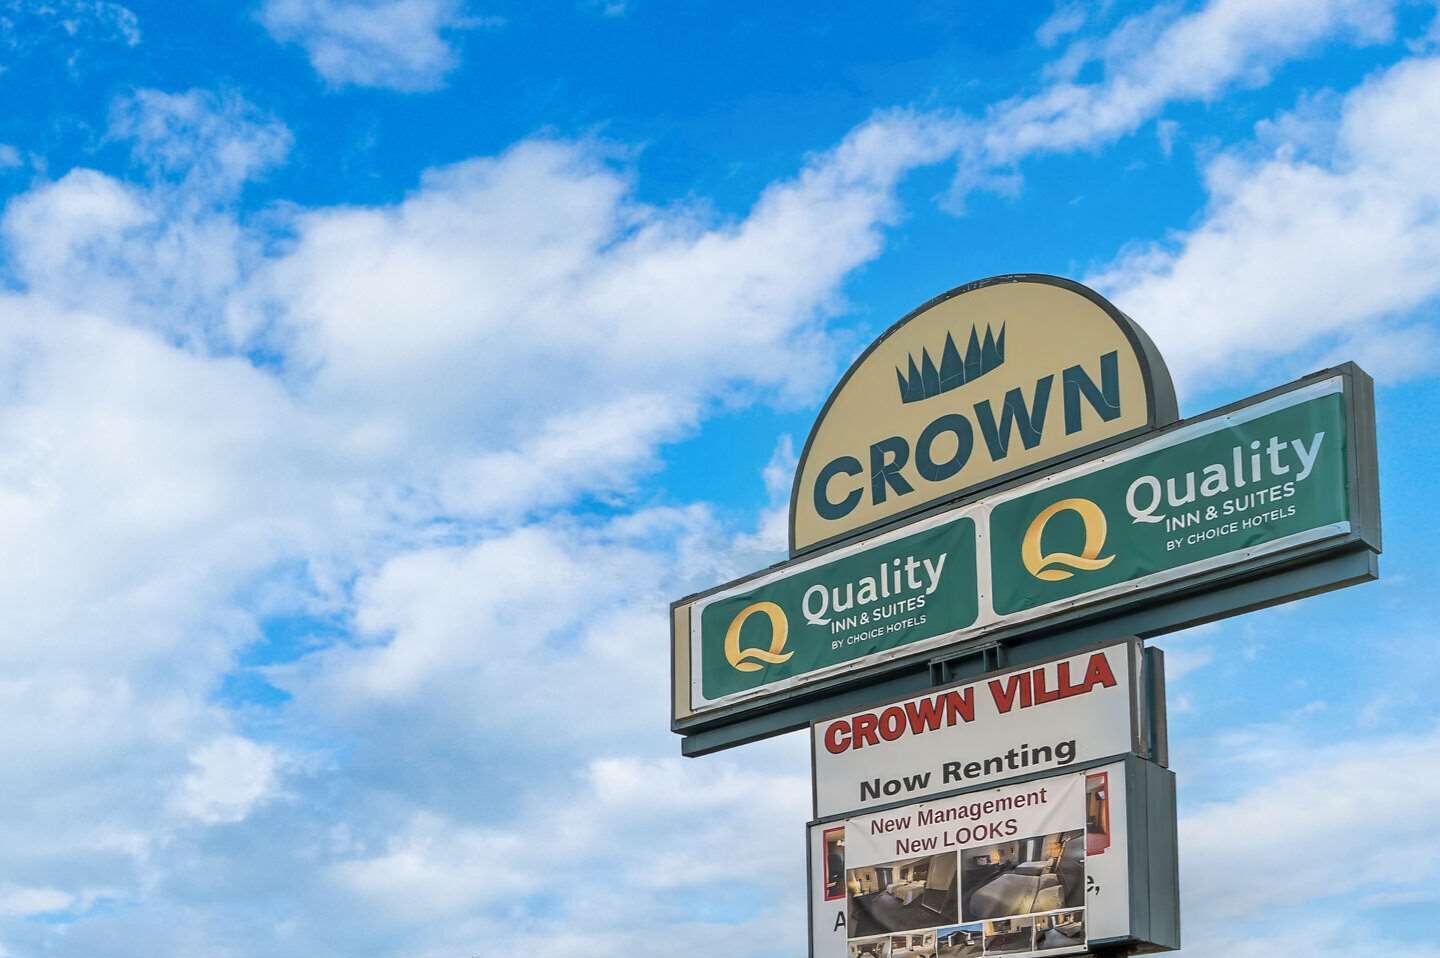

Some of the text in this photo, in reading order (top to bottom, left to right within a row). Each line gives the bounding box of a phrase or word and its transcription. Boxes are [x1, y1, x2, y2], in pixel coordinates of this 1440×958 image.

[813, 350, 1121, 520] CROWN
[1125, 431, 1325, 524] Quality
[1166, 482, 1296, 533] INN & SUITES
[1021, 498, 1116, 581] Q
[1166, 505, 1296, 552] BY CHOICE HOTELS
[801, 552, 947, 626] Quality
[831, 594, 926, 634] INN & SUITES
[724, 601, 794, 672] Q
[831, 614, 927, 650] BY CHOICE HOTELS
[824, 652, 1117, 754] CROWN VILLA
[860, 738, 1077, 802] Now Renting
[871, 787, 1048, 835] New Management
[896, 818, 1018, 856] New LOOKS
